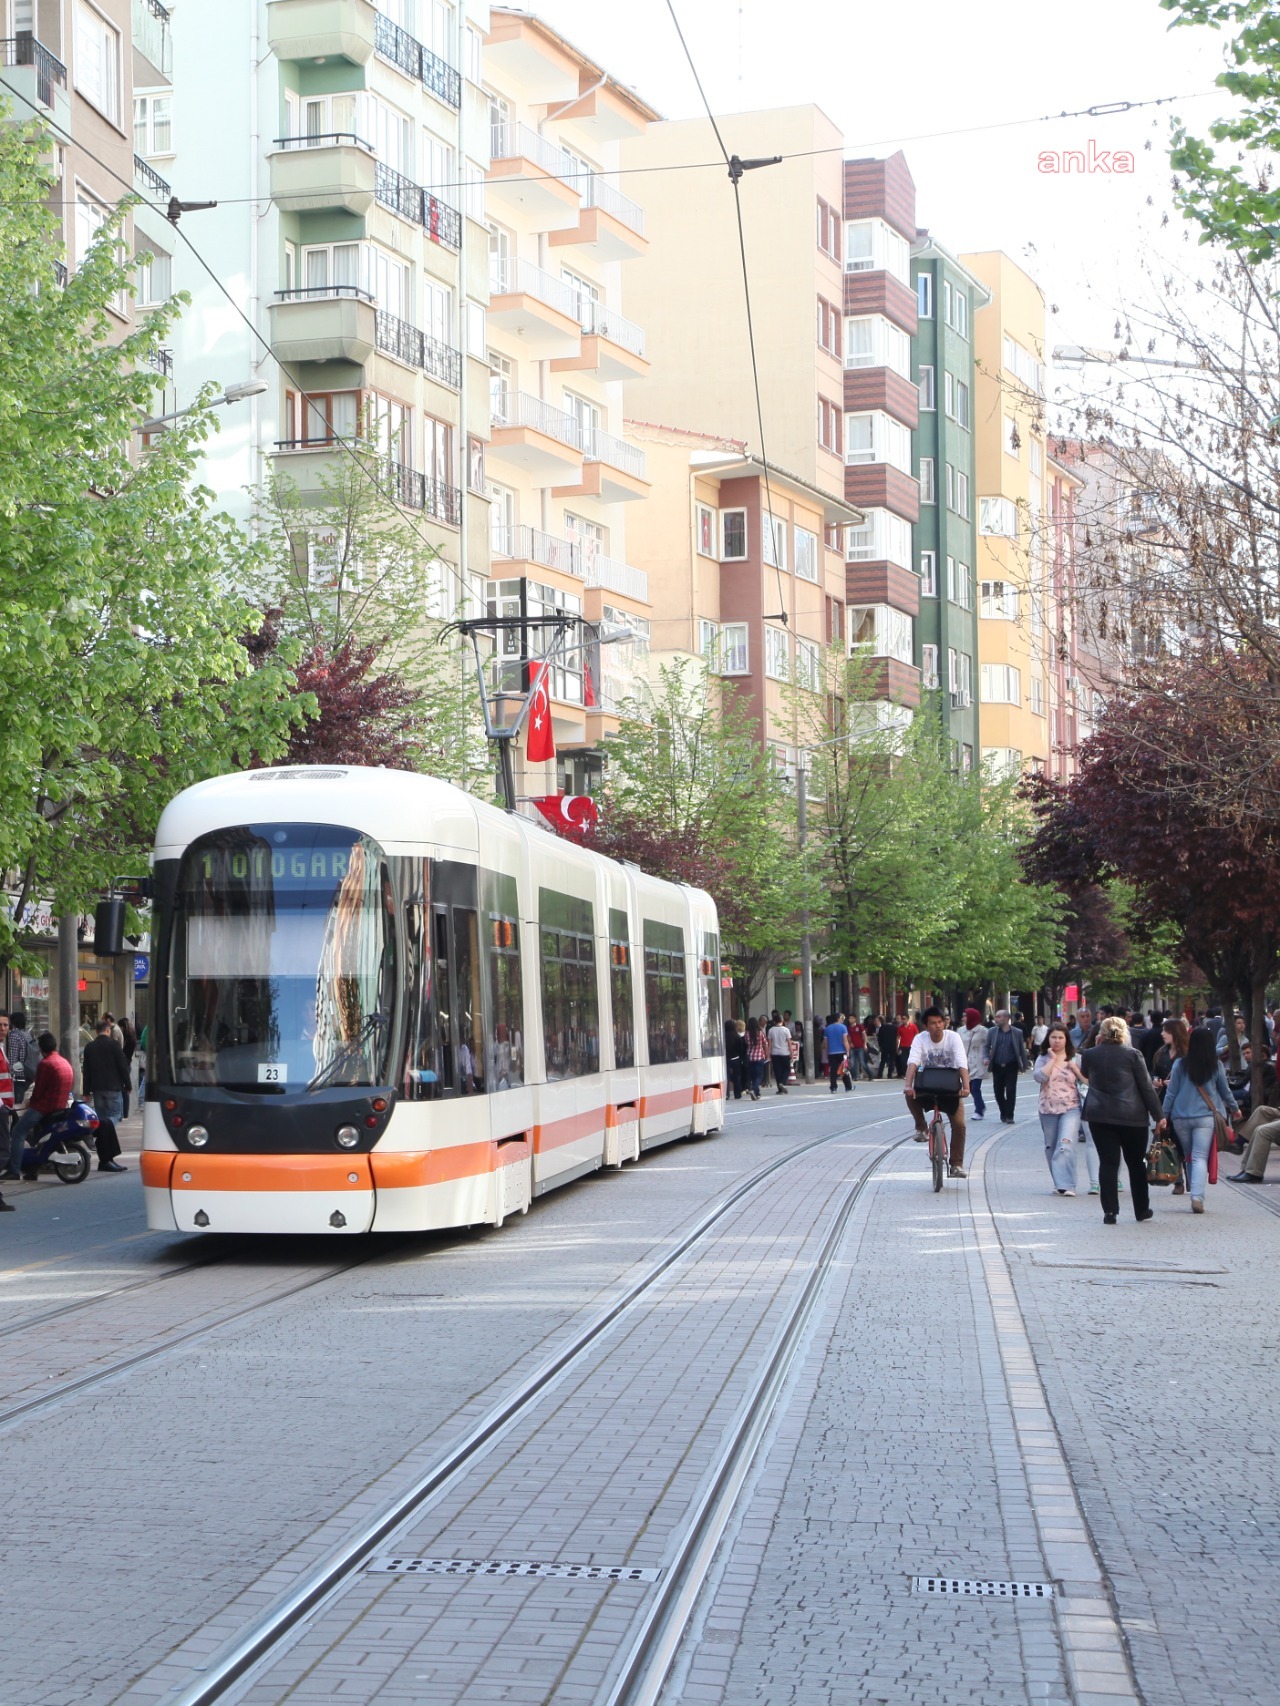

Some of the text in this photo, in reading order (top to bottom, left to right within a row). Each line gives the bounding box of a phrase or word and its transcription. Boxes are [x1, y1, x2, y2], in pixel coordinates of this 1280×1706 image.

[202, 852, 347, 879] 1 OTOGAR
[265, 1069, 279, 1081] 23
